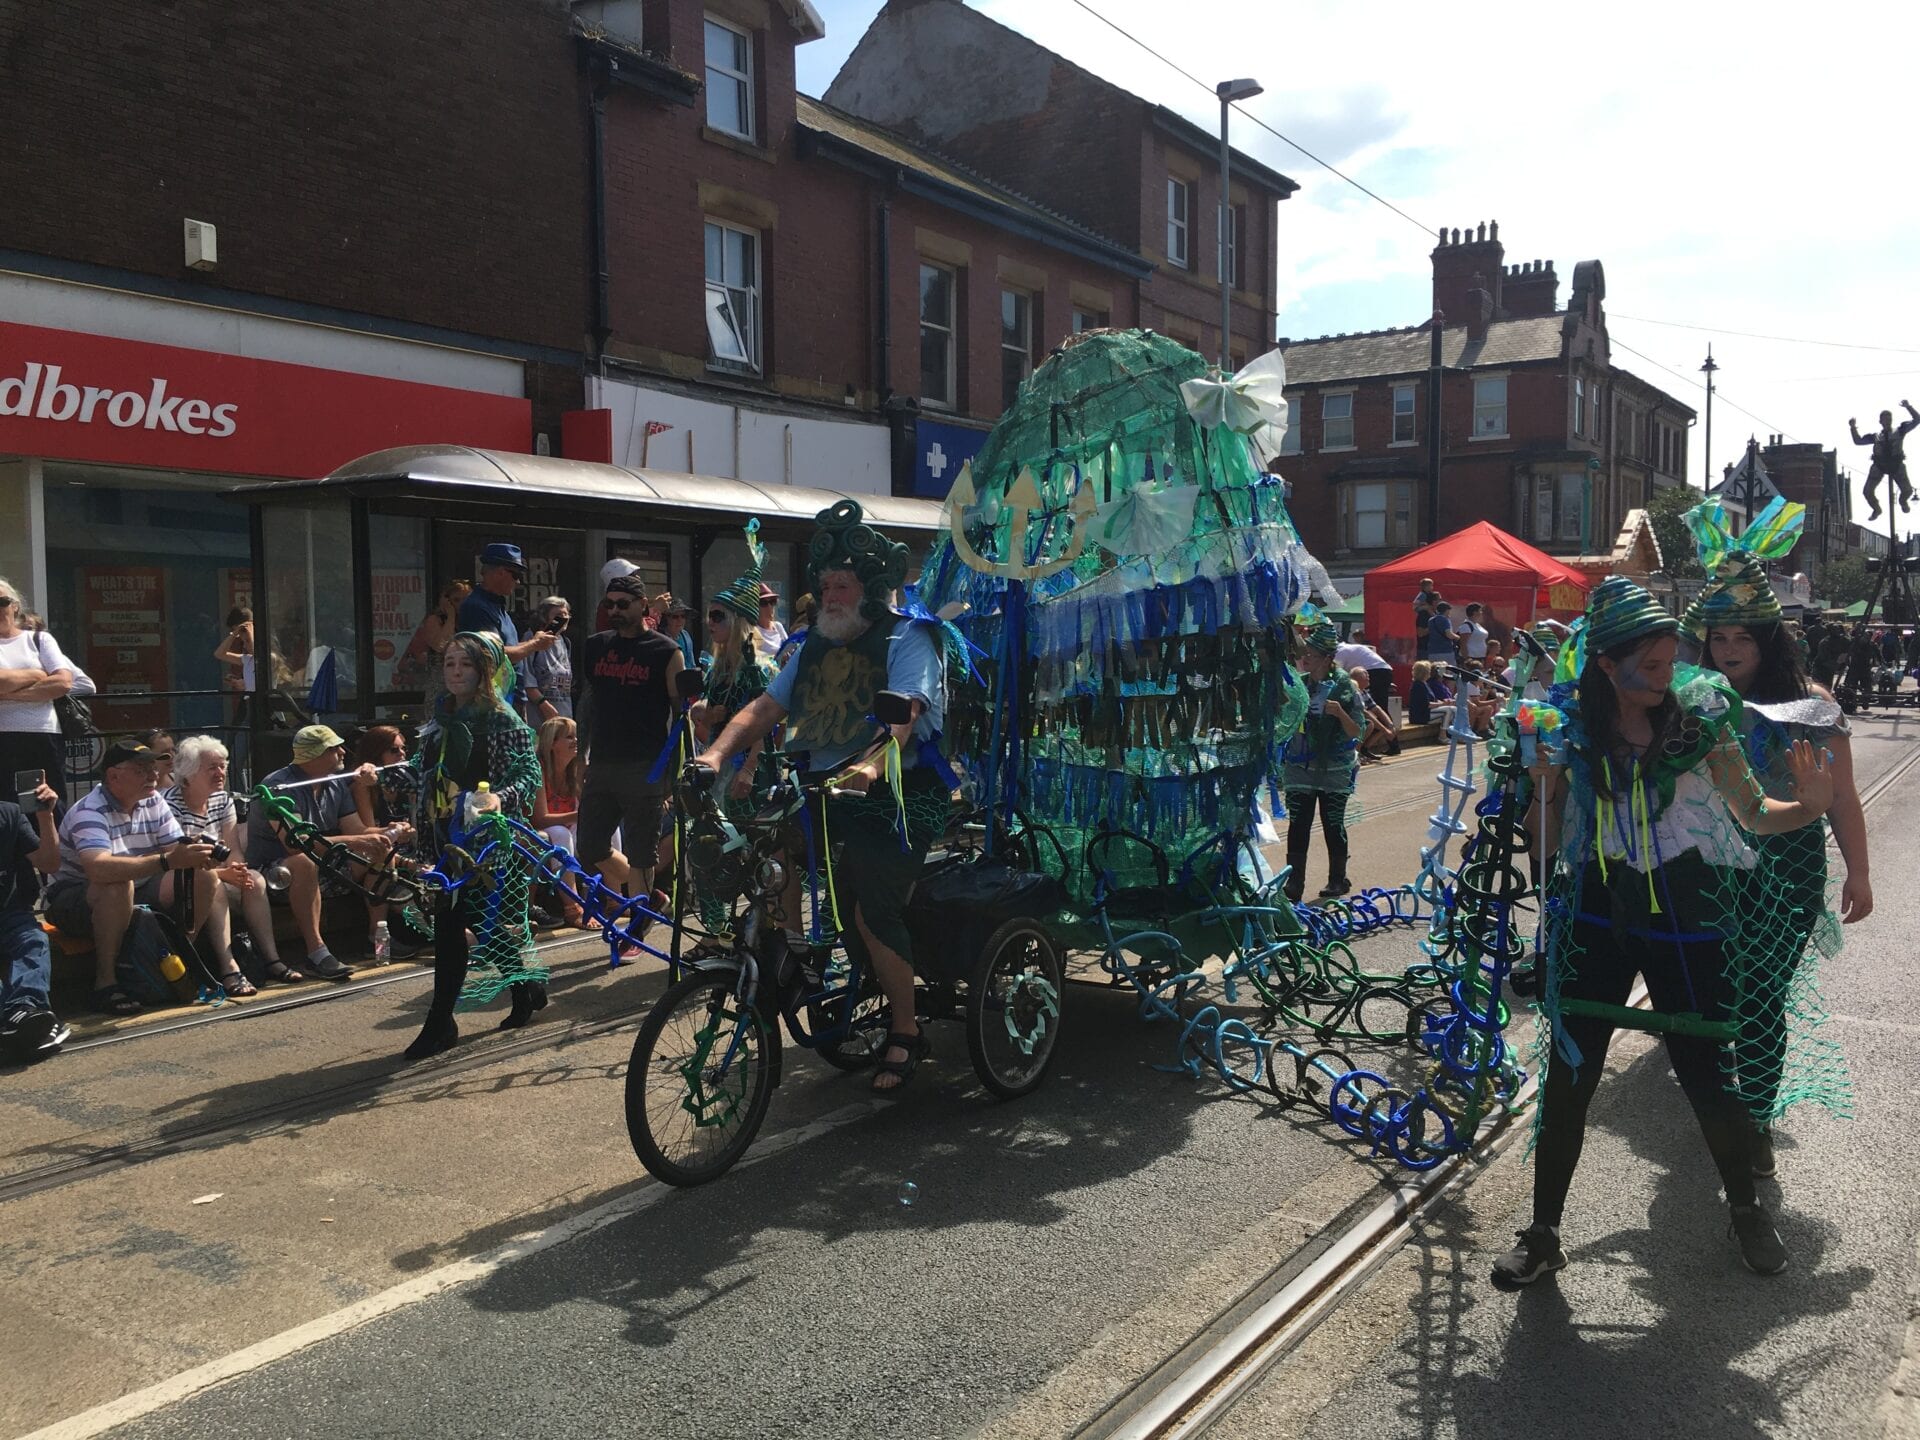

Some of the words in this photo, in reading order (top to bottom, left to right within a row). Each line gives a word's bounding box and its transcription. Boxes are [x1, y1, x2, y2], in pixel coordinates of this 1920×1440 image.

[90, 575, 134, 591] WHAT'S
[135, 575, 157, 590] THE
[372, 576, 421, 593] WORLD
[102, 590, 145, 604] SCORE?
[373, 593, 400, 611] CUP
